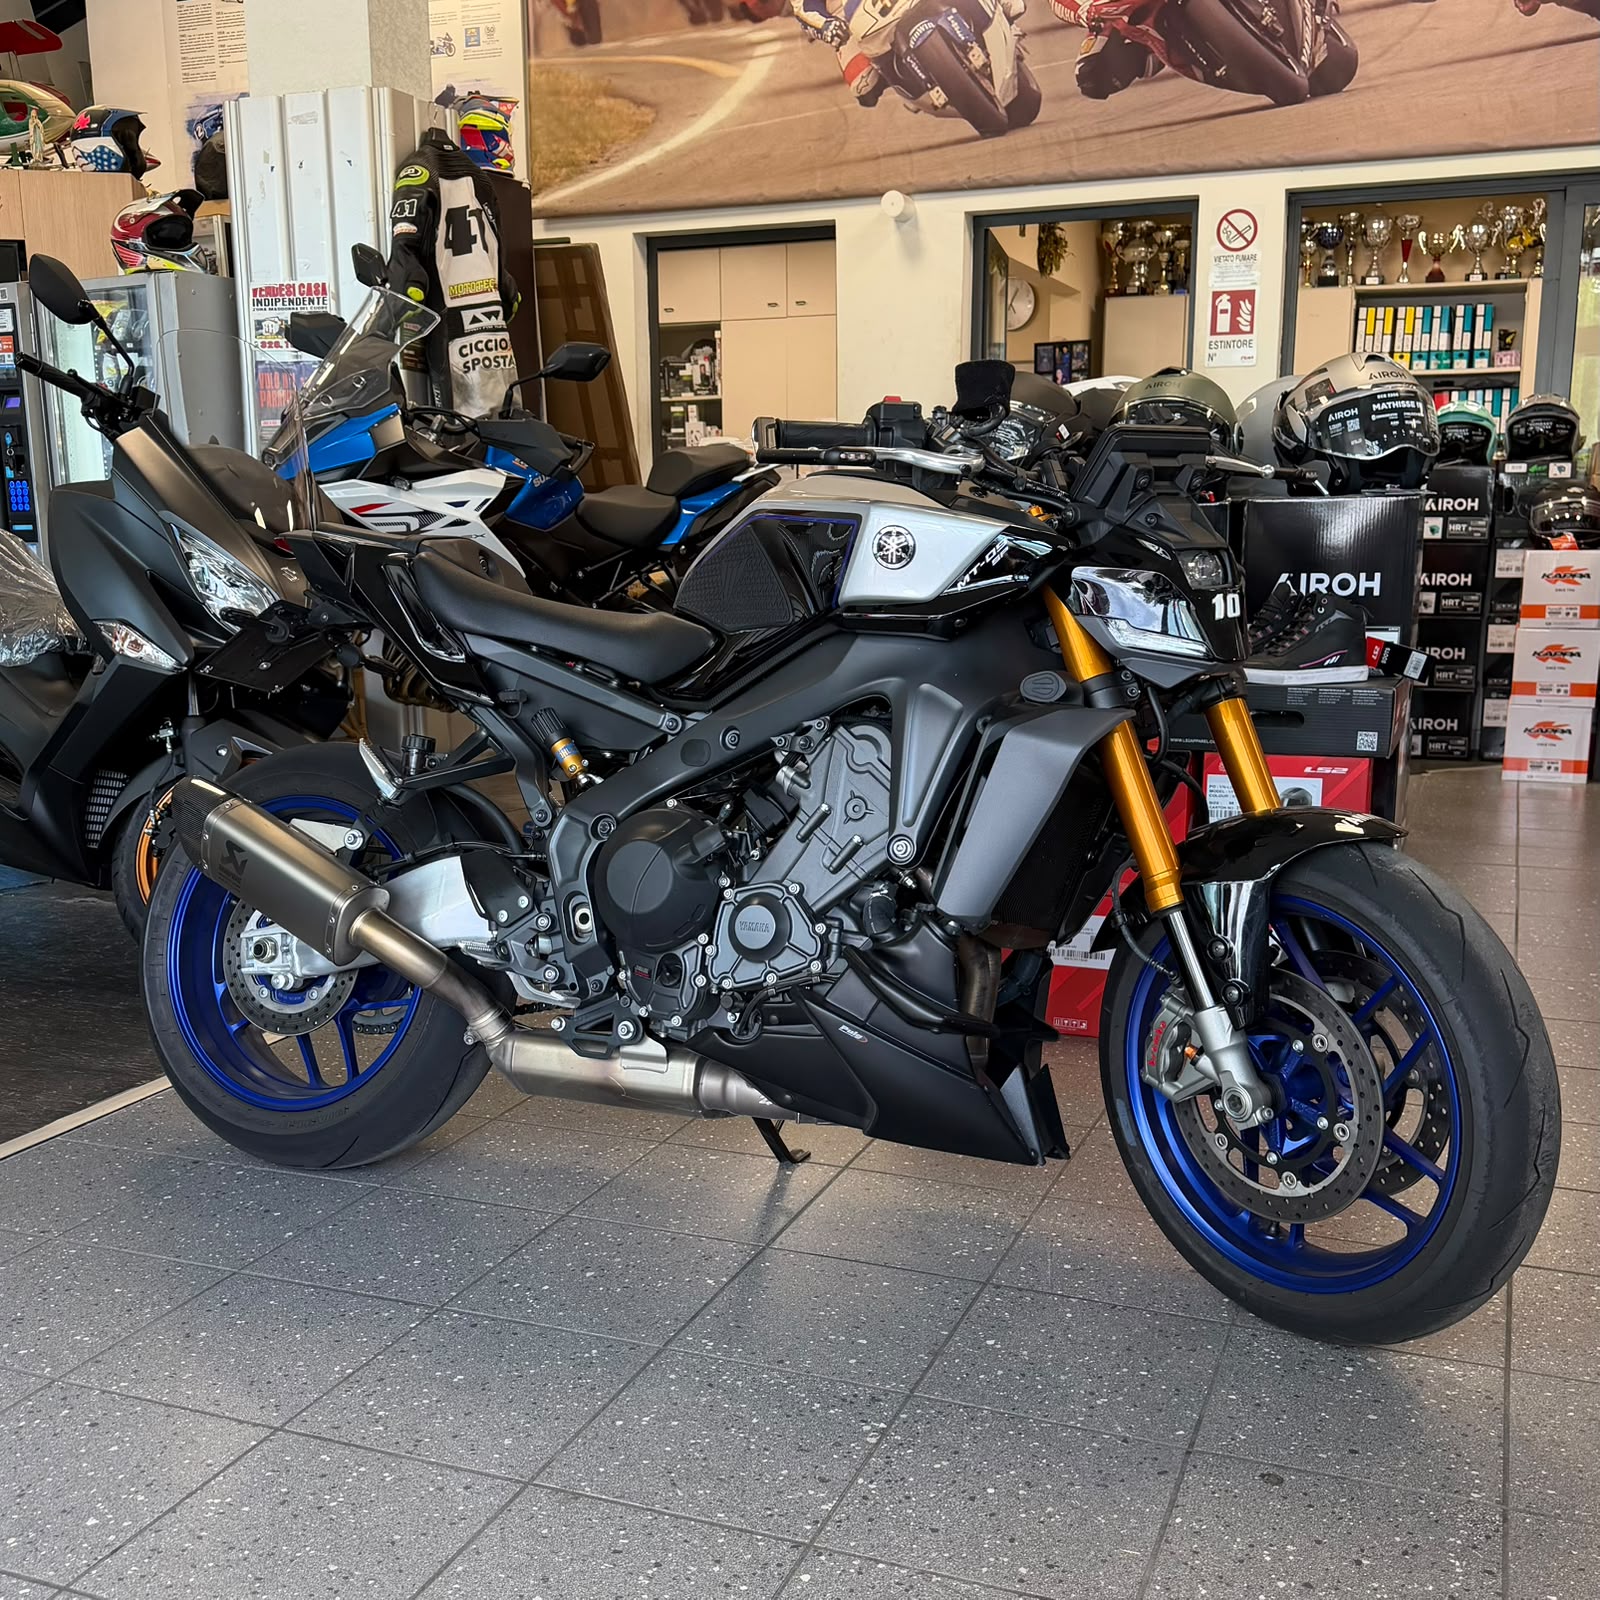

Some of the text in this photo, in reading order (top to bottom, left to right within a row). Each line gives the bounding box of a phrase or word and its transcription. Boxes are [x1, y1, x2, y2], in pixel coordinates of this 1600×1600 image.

[392, 199, 417, 217] 41
[444, 205, 489, 257] 41
[1213, 253, 1257, 263] VIETATO FUMARE
[252, 283, 328, 297] VENDESI CASA
[252, 297, 328, 307] INDIPENDENTE
[458, 338, 509, 358] CICCIO
[1208, 339, 1254, 350] ESTINTORE
[463, 355, 516, 374] SPOSTA
[1369, 371, 1407, 380] AIROH
[1372, 400, 1416, 411] MATHISSE
[1328, 407, 1359, 422] AIROH
[1425, 498, 1479, 511] AIROH
[1420, 573, 1472, 586] AIROH
[1211, 593, 1241, 621] 10
[1303, 766, 1349, 775] LS2
